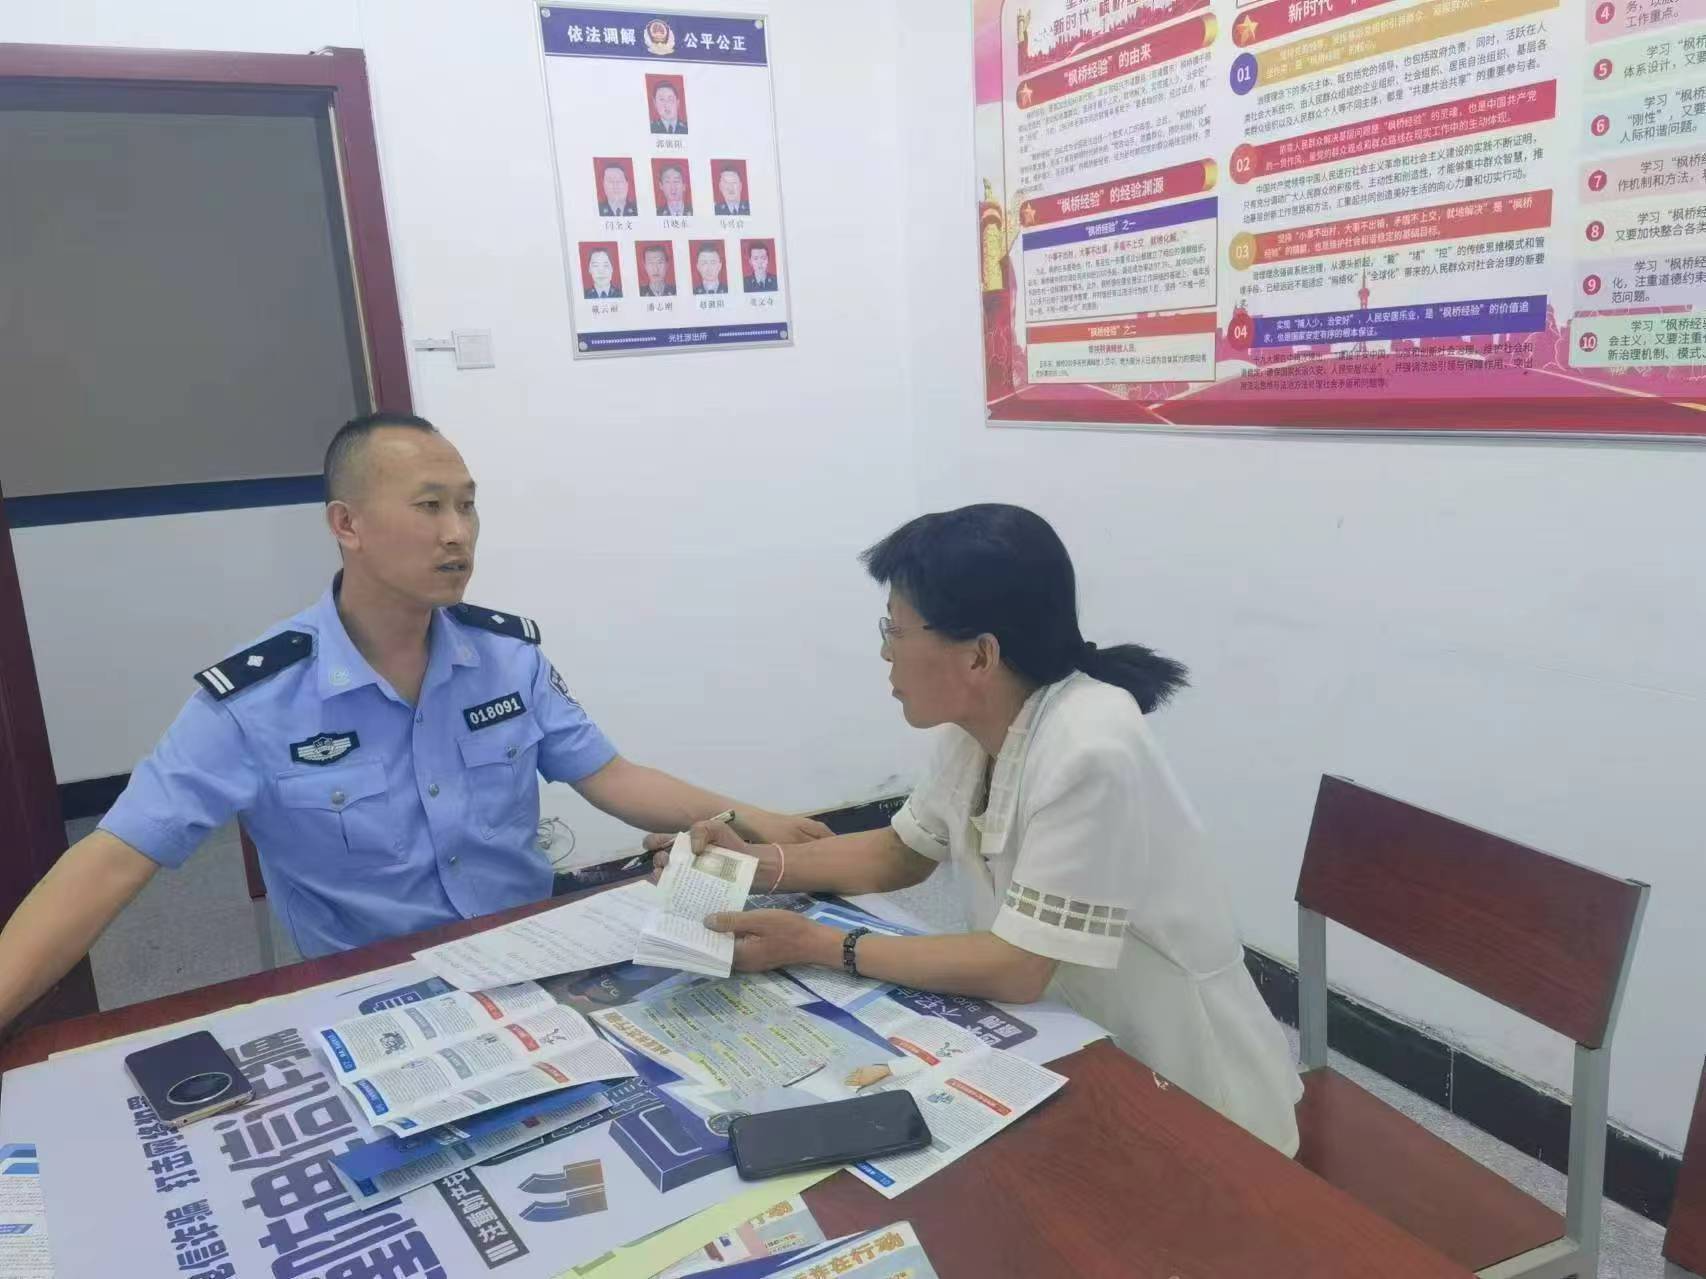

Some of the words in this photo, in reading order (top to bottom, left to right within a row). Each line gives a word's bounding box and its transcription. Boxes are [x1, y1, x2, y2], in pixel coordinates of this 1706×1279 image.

[1626, 9, 1679, 28] 工作重点。
[567, 24, 636, 46] 依法调解
[684, 31, 747, 52] 公平公正
[1236, 66, 1251, 82] 01
[1599, 62, 1608, 77] 5
[1597, 119, 1606, 133] 6
[1620, 121, 1697, 144] 人际和谐问题。
[1236, 157, 1250, 172] 02
[1593, 175, 1602, 189] 7
[1591, 224, 1599, 238] 8
[1235, 245, 1249, 259] 03
[1588, 278, 1597, 292] 9
[1611, 290, 1650, 304] 范问题。
[1234, 325, 1248, 339] 04
[1608, 332, 1706, 346] 会主义，又要注重
[1582, 335, 1597, 349] 10
[469, 698, 521, 725] 018091
